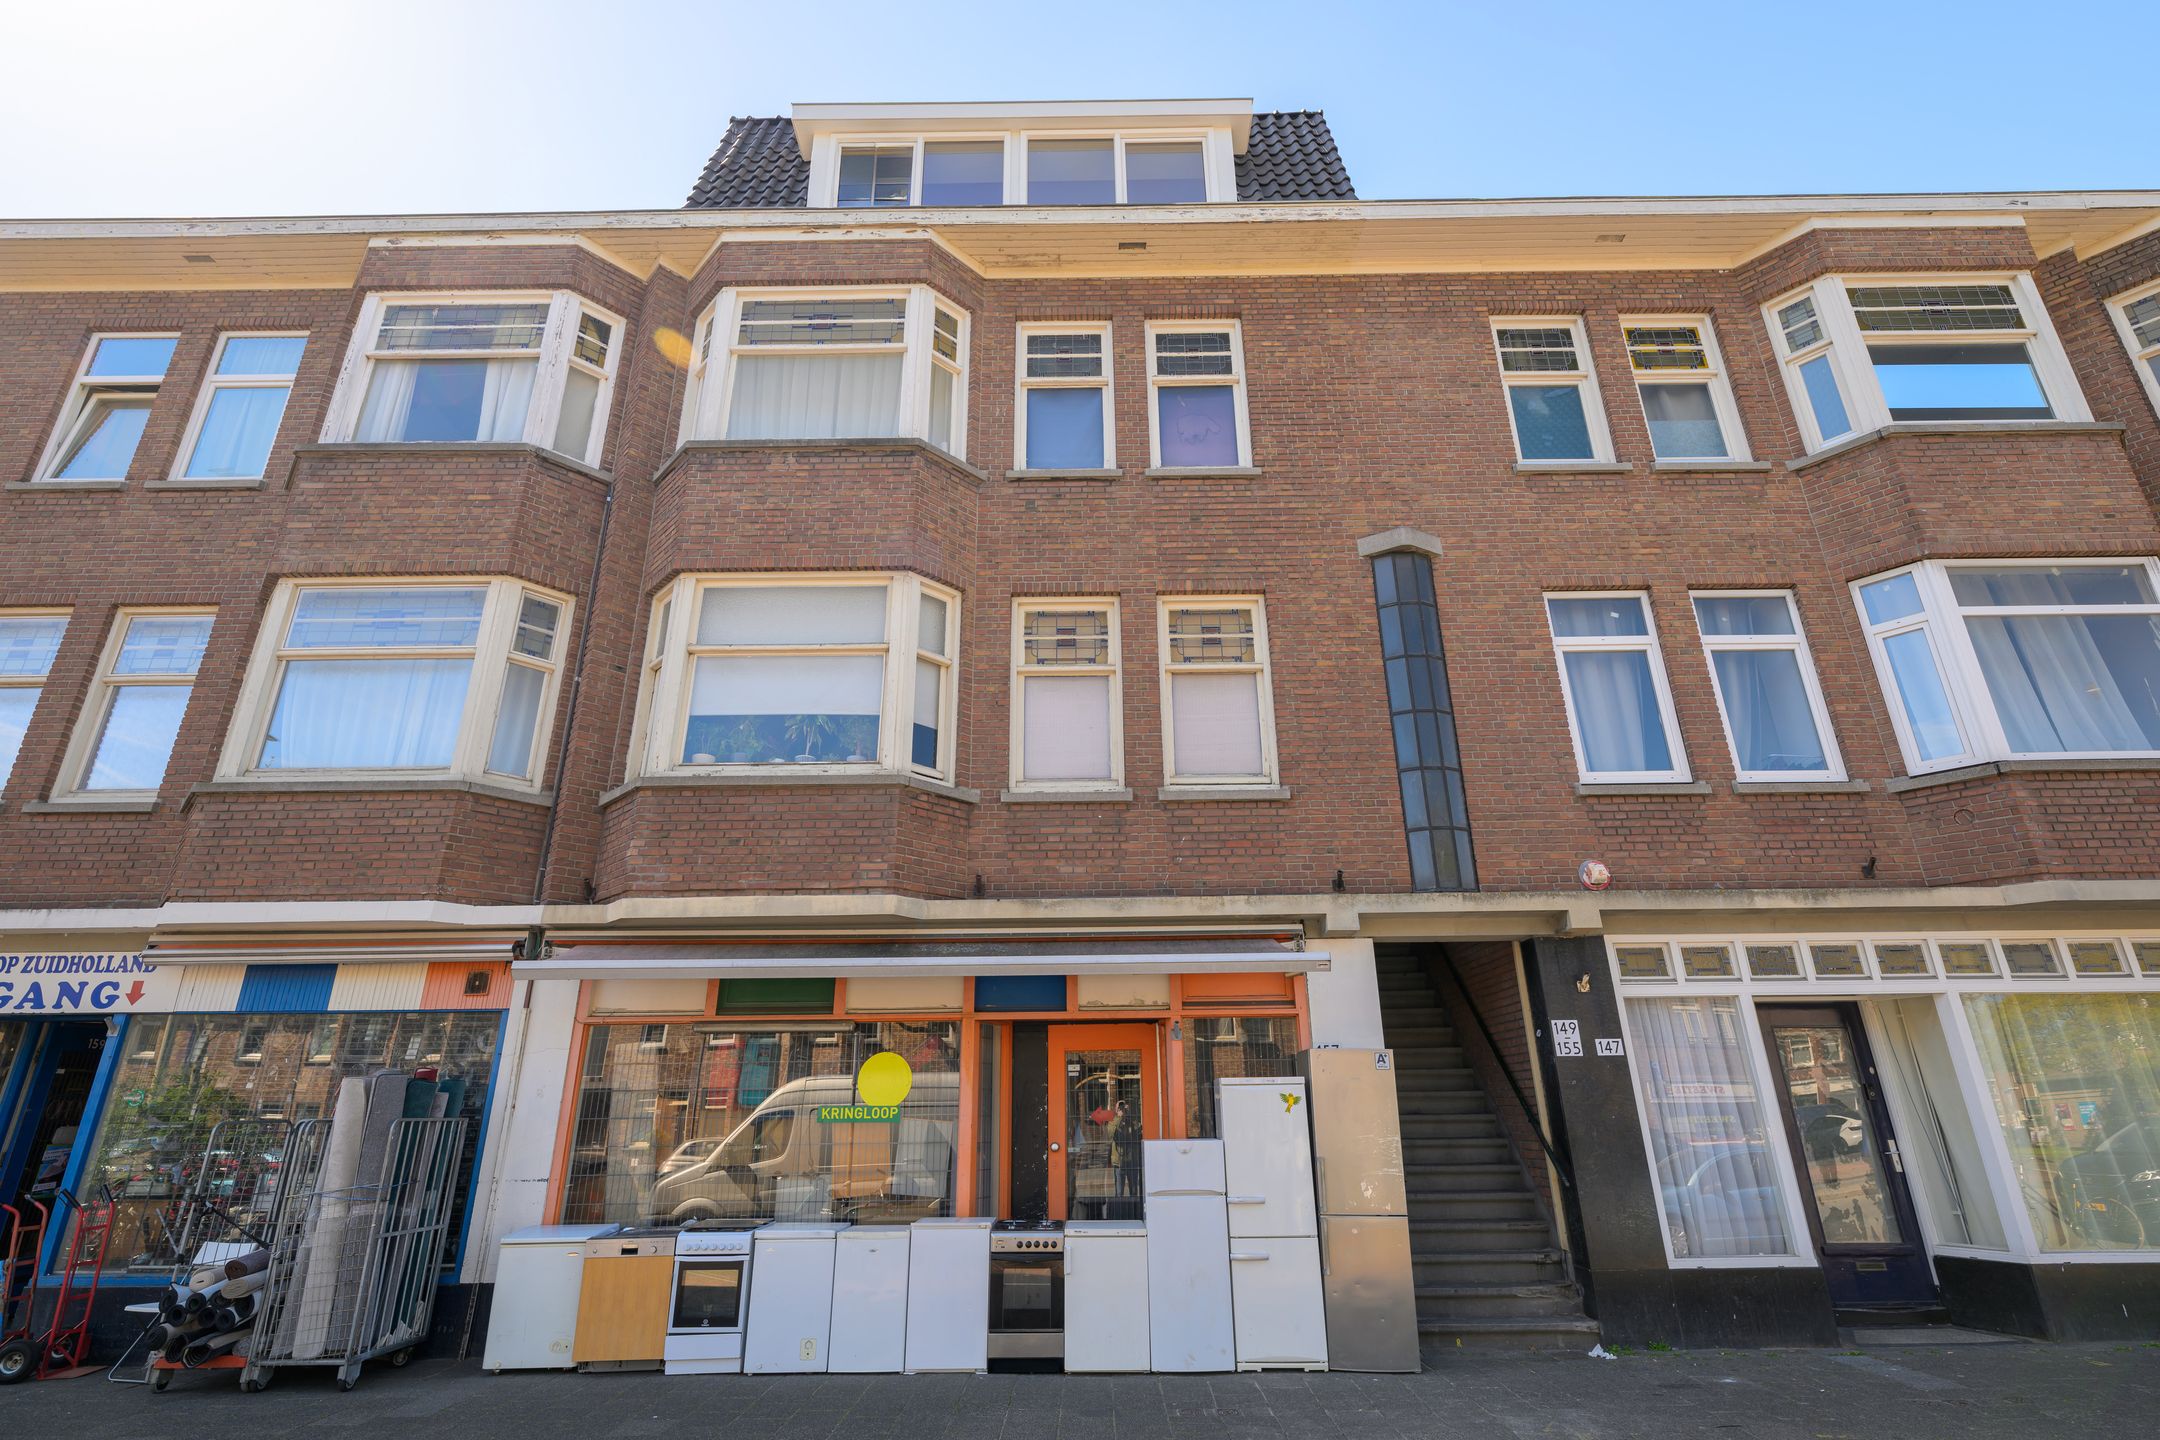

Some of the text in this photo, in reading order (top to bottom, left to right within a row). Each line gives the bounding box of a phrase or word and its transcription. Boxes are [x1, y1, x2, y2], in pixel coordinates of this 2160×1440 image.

[1553, 1021, 1577, 1035] 149
[87, 1038, 106, 1050] 159
[1557, 1041, 1581, 1055] 155
[1598, 1040, 1620, 1054] 147
[821, 1106, 899, 1120] KRINGLOOP
